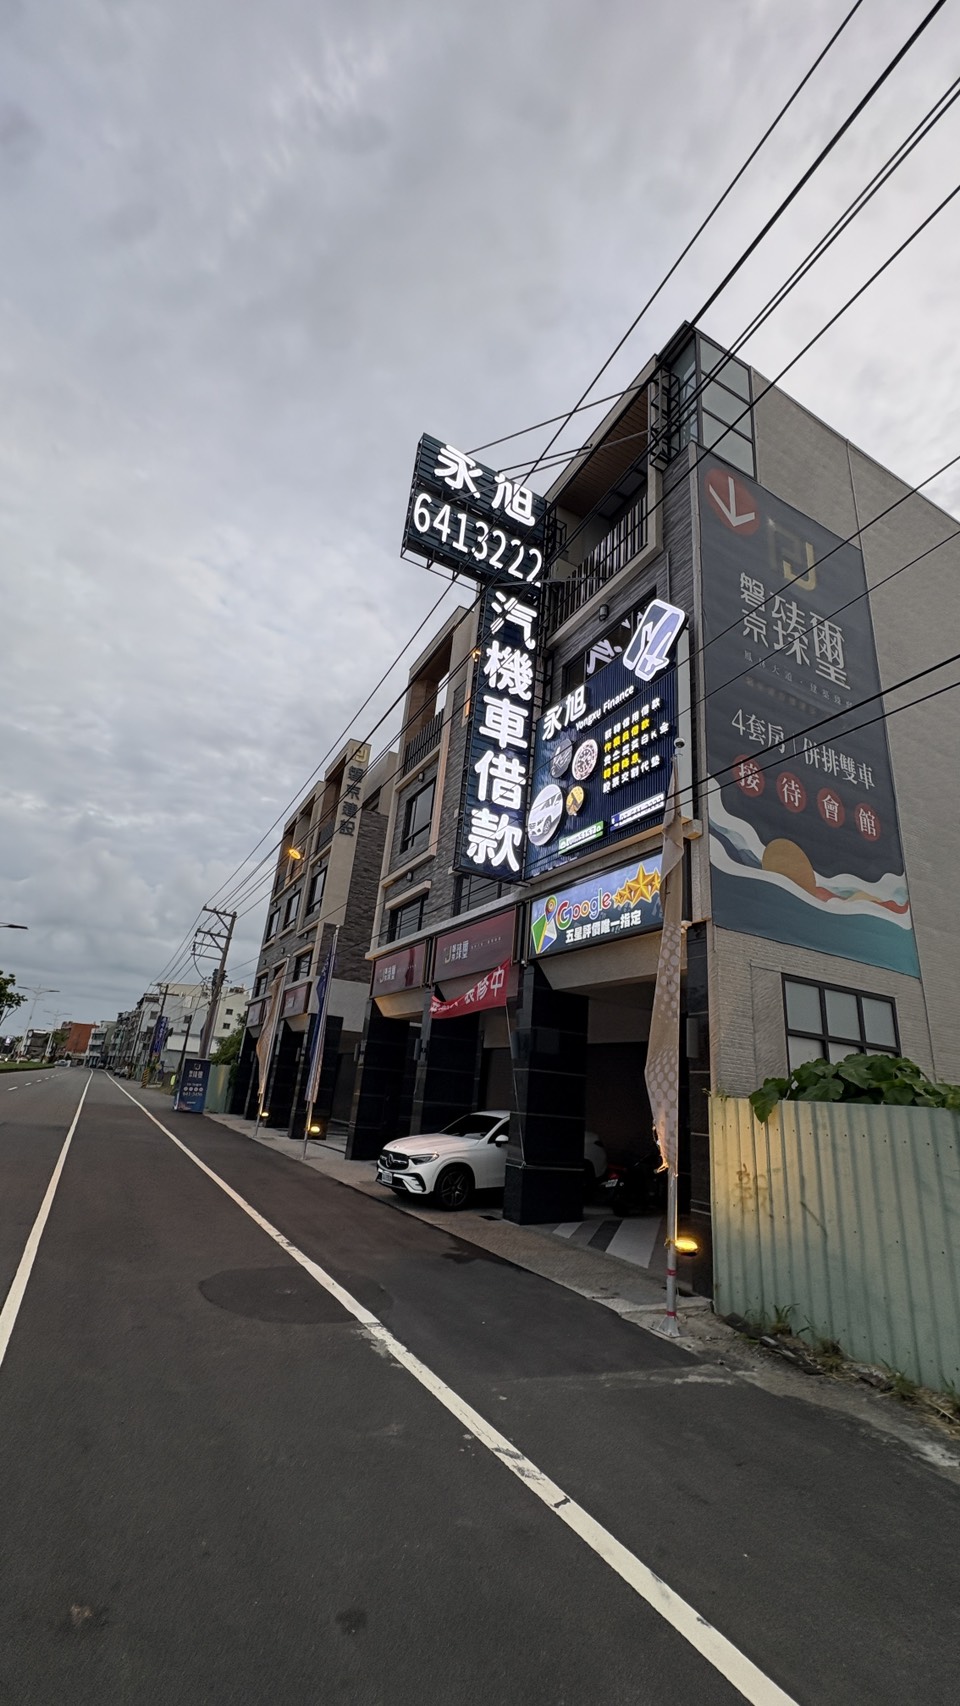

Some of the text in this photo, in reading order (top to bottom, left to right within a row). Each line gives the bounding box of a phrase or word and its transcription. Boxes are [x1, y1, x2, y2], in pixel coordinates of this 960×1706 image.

[434, 444, 536, 527] 永旭
[413, 493, 543, 588] 6413222
[466, 591, 537, 872] 汽機車借款
[542, 684, 587, 741] 永旭
[575, 685, 635, 731] Yongxu Finance
[738, 759, 877, 837] 接待會館
[555, 887, 612, 931] Google
[565, 909, 642, 944] 五星評價唯一指定
